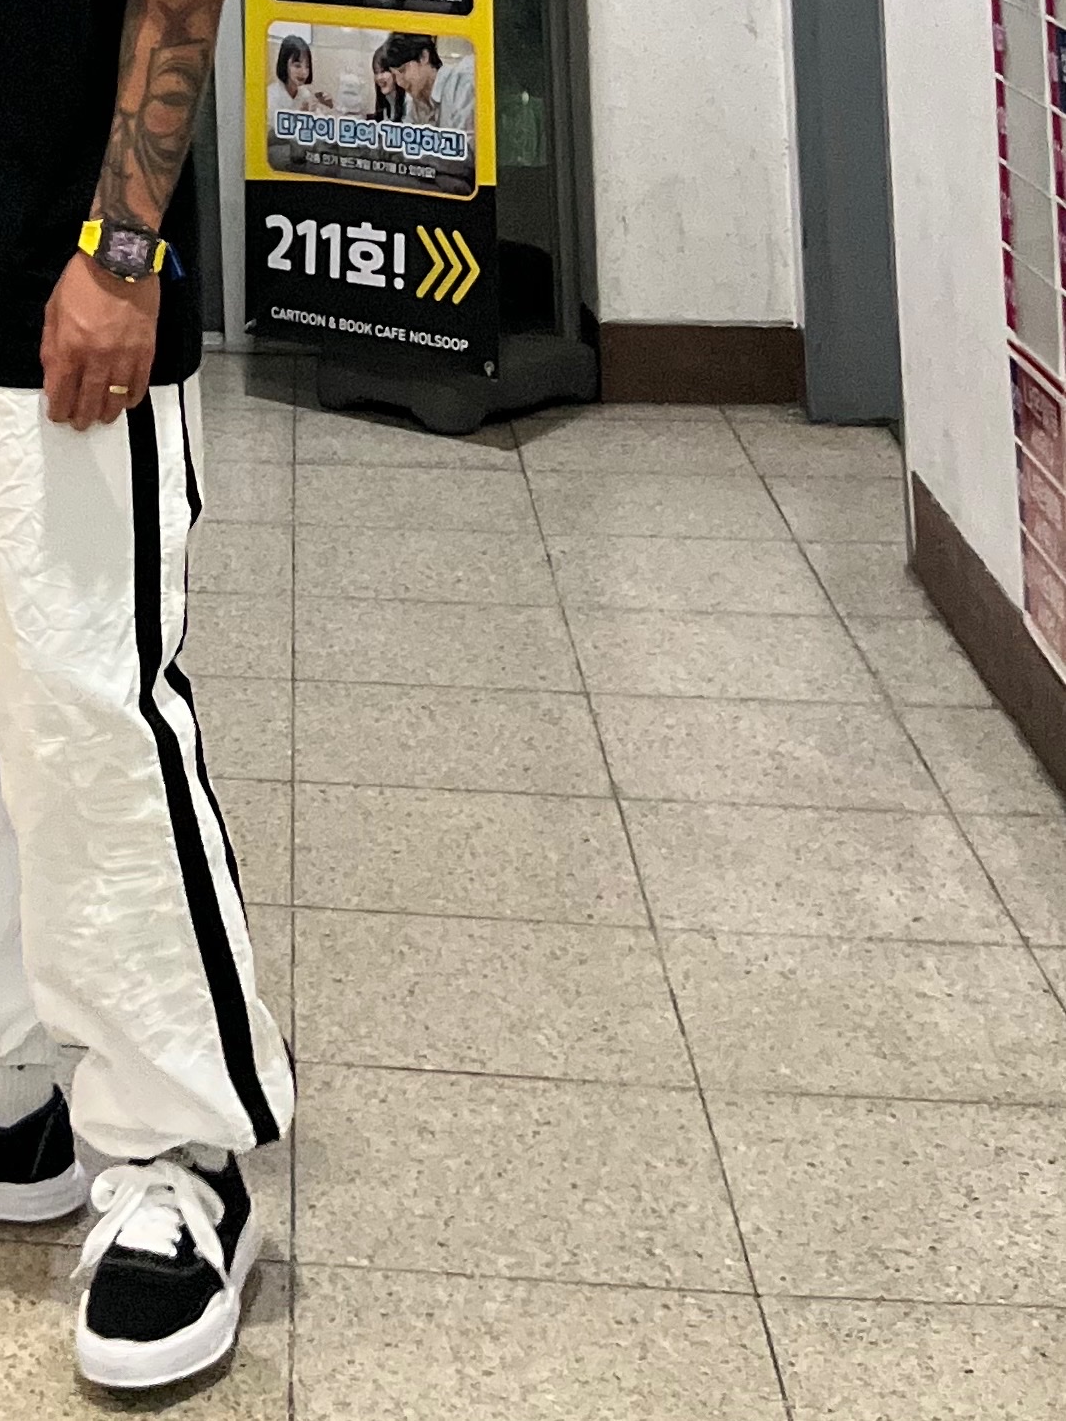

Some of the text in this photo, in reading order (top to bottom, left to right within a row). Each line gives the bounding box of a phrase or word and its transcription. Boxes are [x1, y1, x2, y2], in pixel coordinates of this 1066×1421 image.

[277, 111, 465, 157] 다같이 모여 게임하고!
[265, 214, 406, 290] 211호!
[270, 306, 469, 352] CARTOON & BOOK CAFE NOLSOOP
